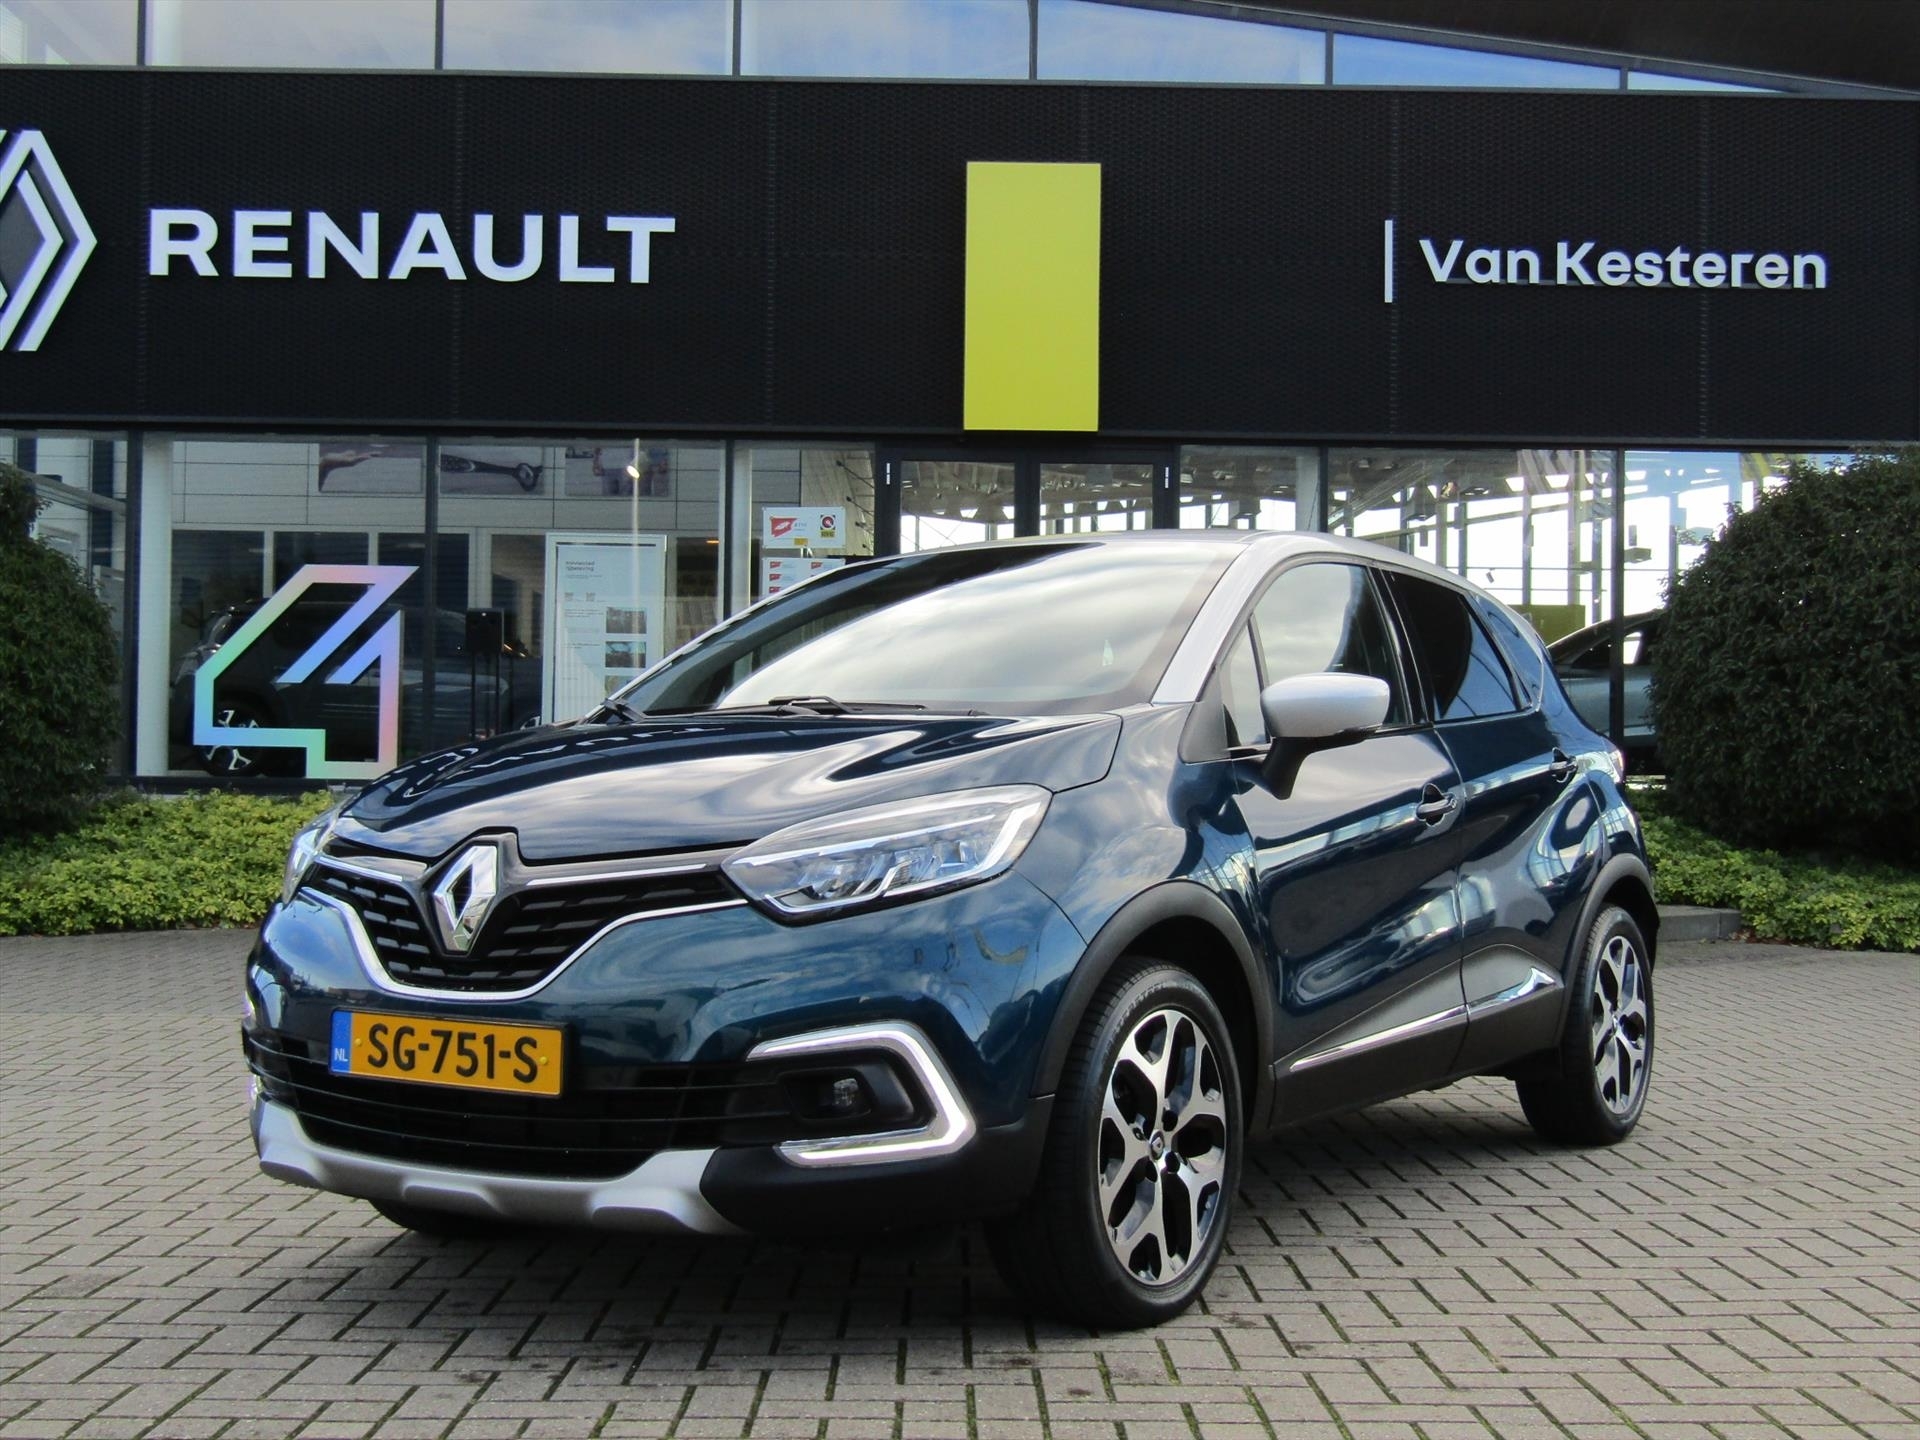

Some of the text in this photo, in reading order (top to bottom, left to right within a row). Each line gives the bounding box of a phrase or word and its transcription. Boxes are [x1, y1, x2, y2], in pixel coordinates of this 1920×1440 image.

[149, 208, 676, 284] RENAULT
[1419, 239, 1826, 289] Van Kesteren
[334, 1047, 349, 1062] NL
[367, 1023, 538, 1084] SG-751-S
